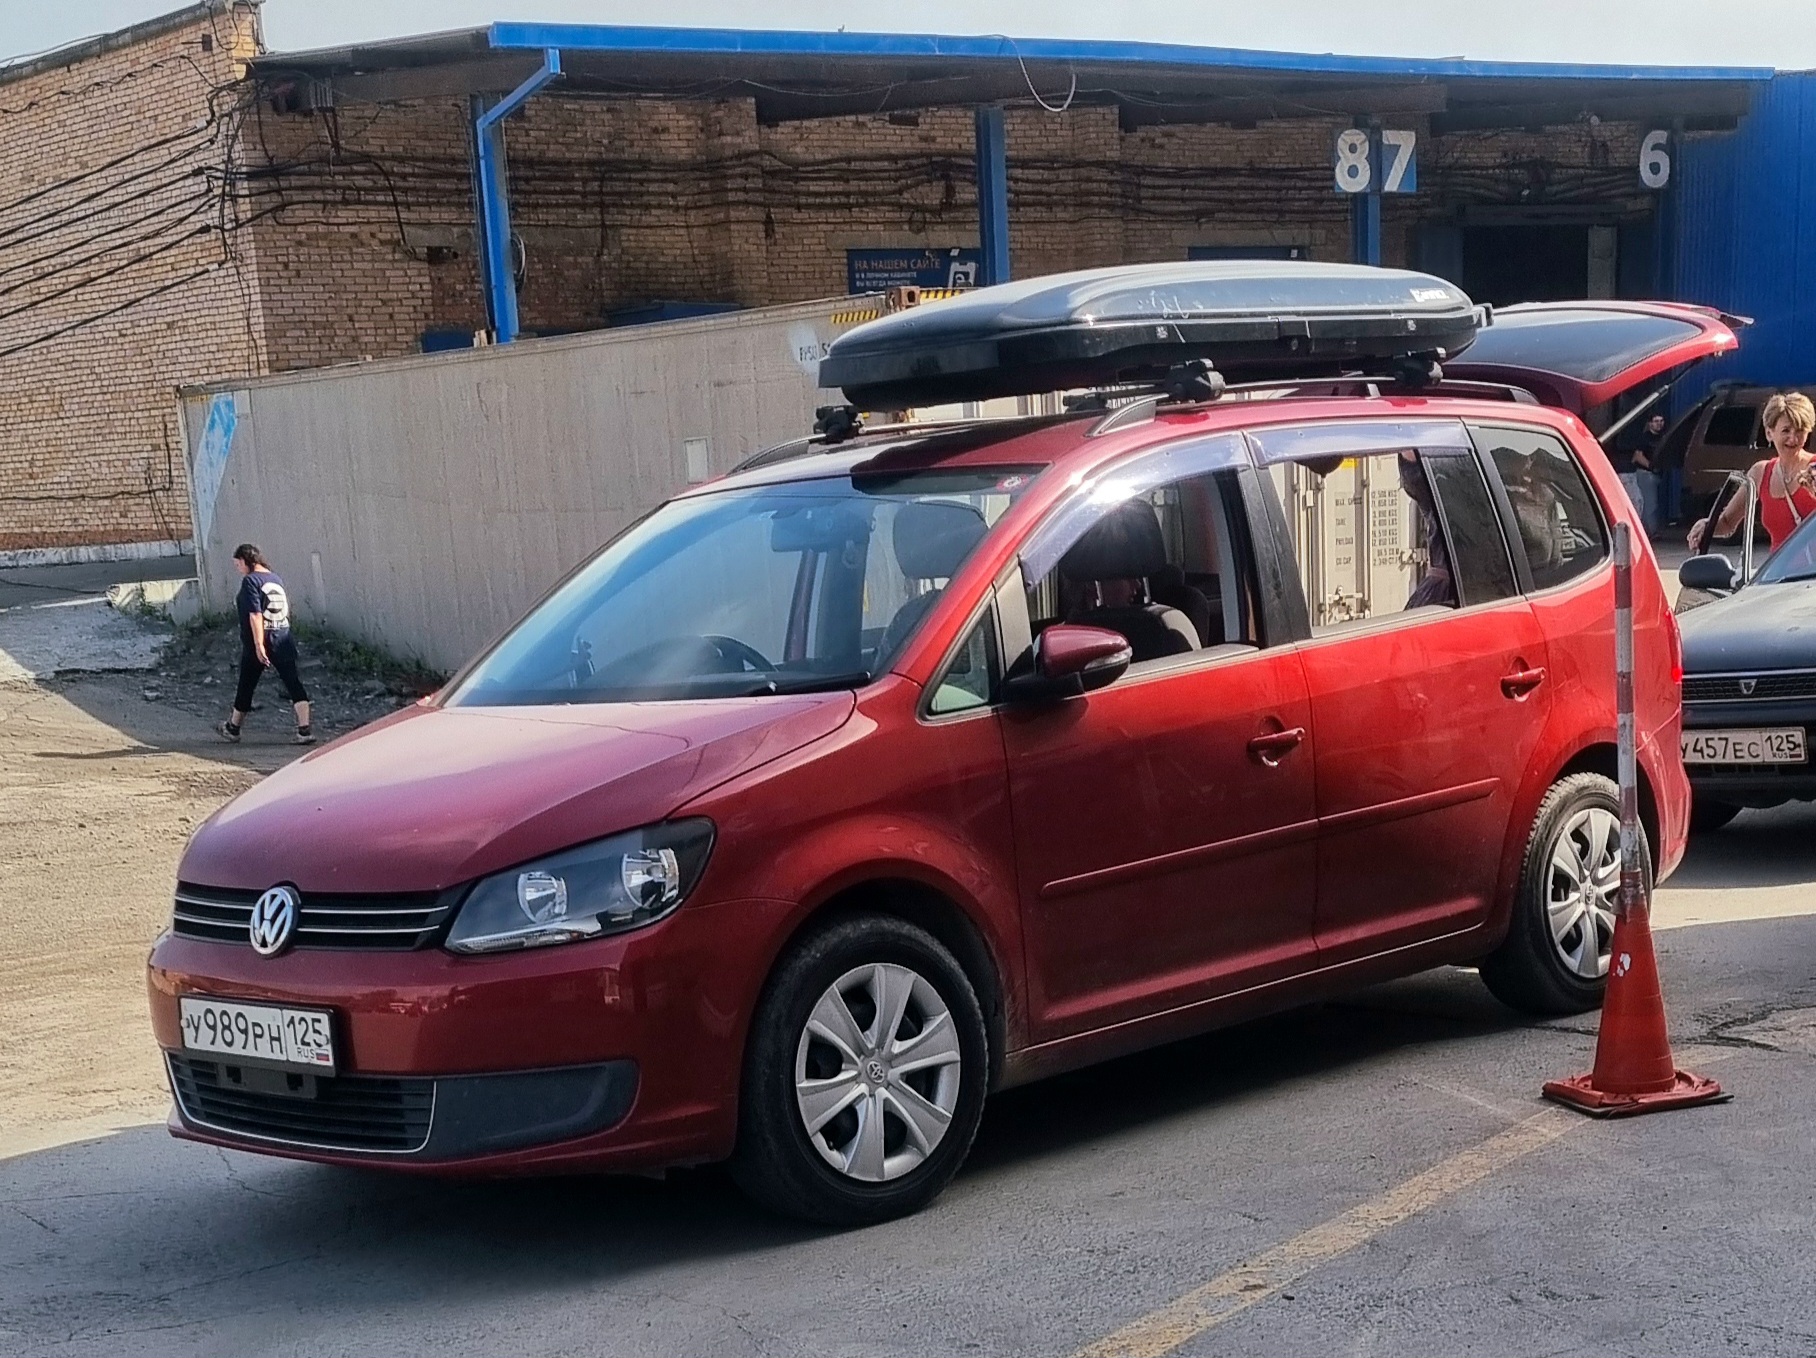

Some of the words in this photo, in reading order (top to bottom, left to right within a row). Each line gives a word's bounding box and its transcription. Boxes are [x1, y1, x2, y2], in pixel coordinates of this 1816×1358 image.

[1335, 128, 1371, 193] 8
[1382, 129, 1416, 192] 7
[1639, 129, 1671, 189] 6
[855, 260, 869, 270] НА
[871, 259, 908, 270] НАШЕМ
[910, 258, 941, 269] САЙТЕ
[1681, 737, 1760, 759] У457ЕС
[1764, 734, 1797, 752] 125
[251, 888, 292, 953] VW
[189, 1007, 284, 1055] У989РН
[286, 1015, 330, 1048] 125
[296, 1047, 316, 1059] RUS
